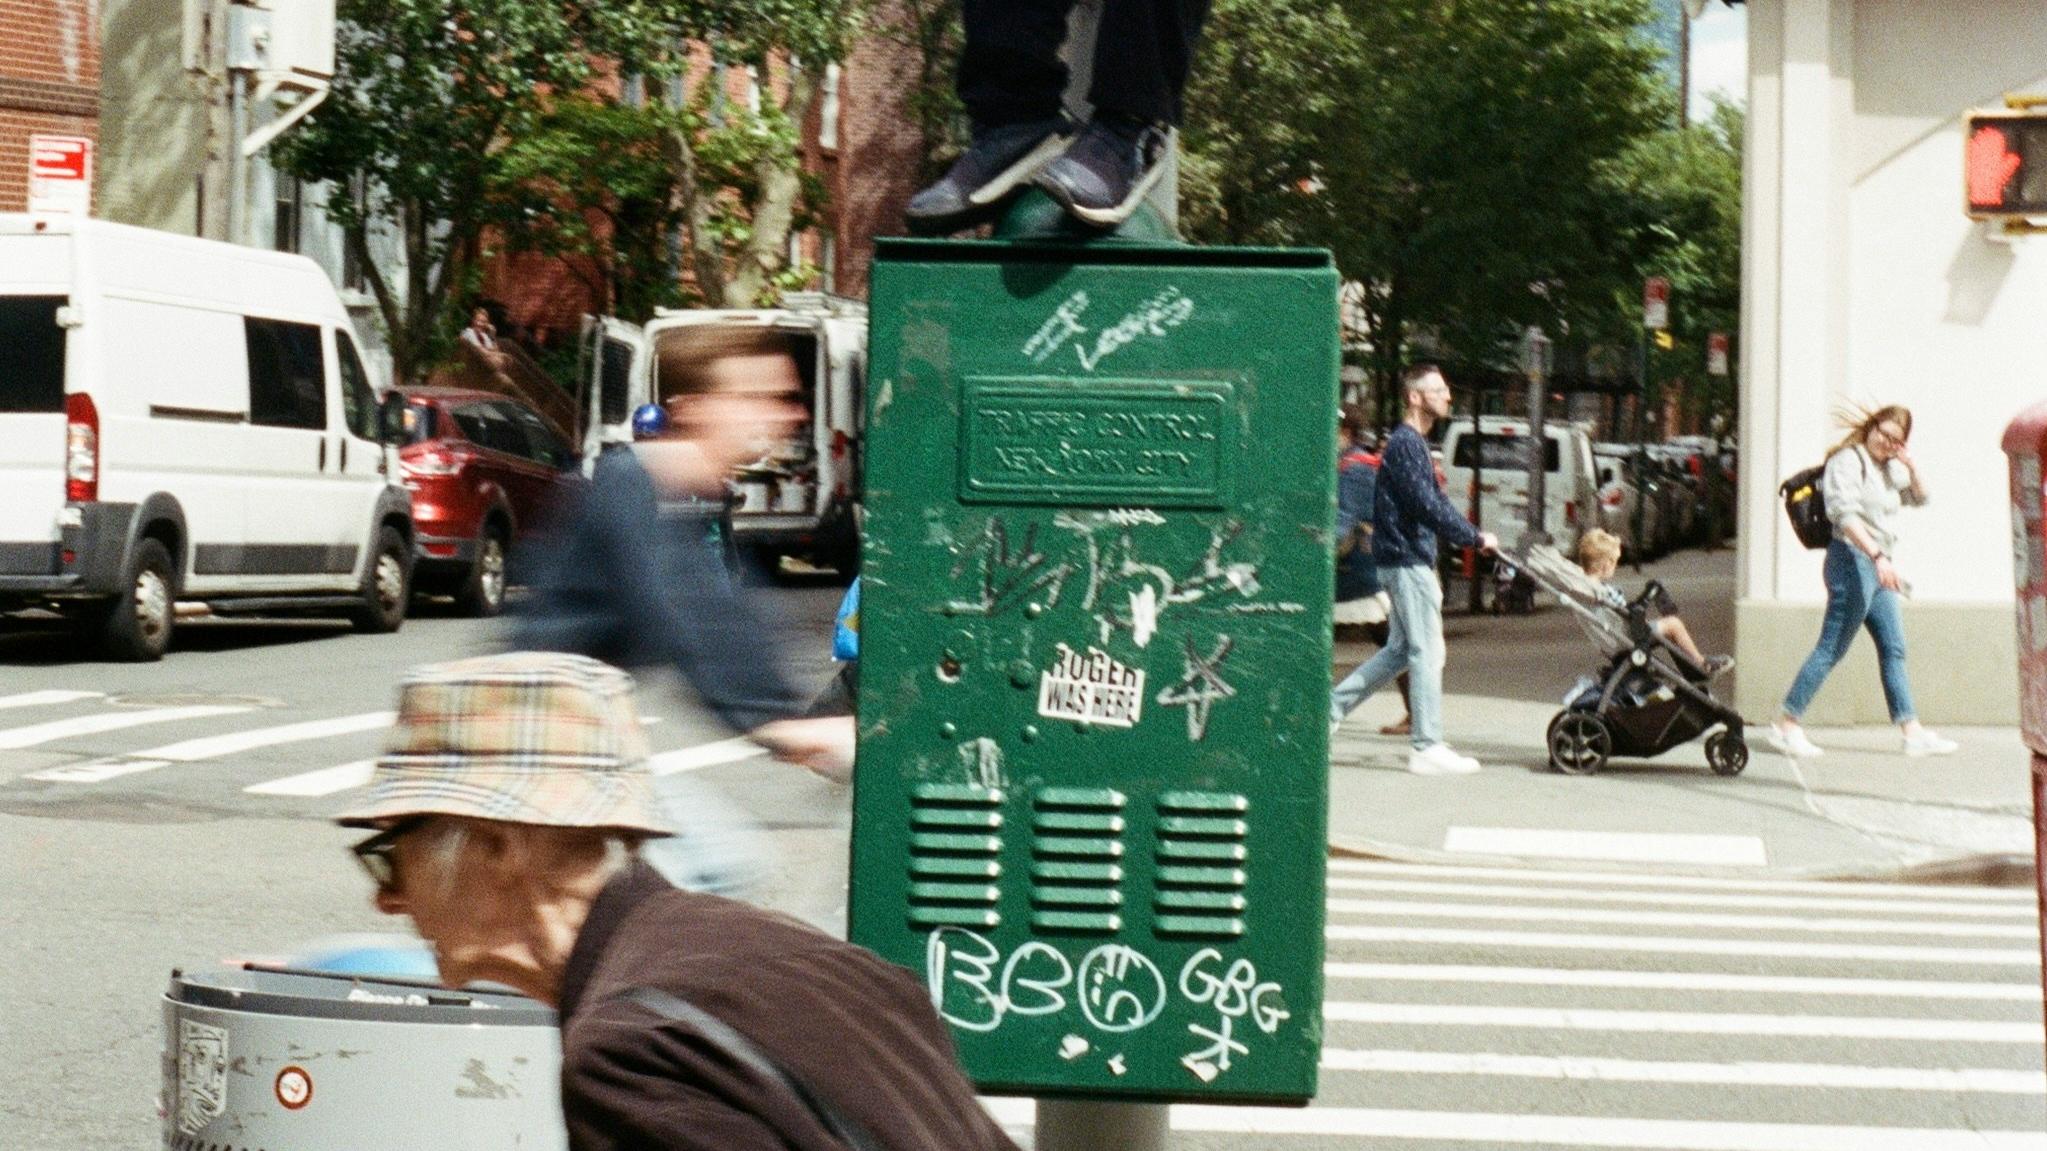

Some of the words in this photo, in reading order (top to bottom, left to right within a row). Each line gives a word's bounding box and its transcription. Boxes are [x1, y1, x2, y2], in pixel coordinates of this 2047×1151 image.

[978, 408, 1086, 437] TRAFFIC
[1097, 411, 1216, 441] CONTROL
[994, 446, 1056, 475] NEW
[1058, 446, 1128, 476] YORK
[1136, 450, 1196, 477] CITY
[1046, 680, 1087, 715] WAS
[1092, 685, 1136, 722] HERE
